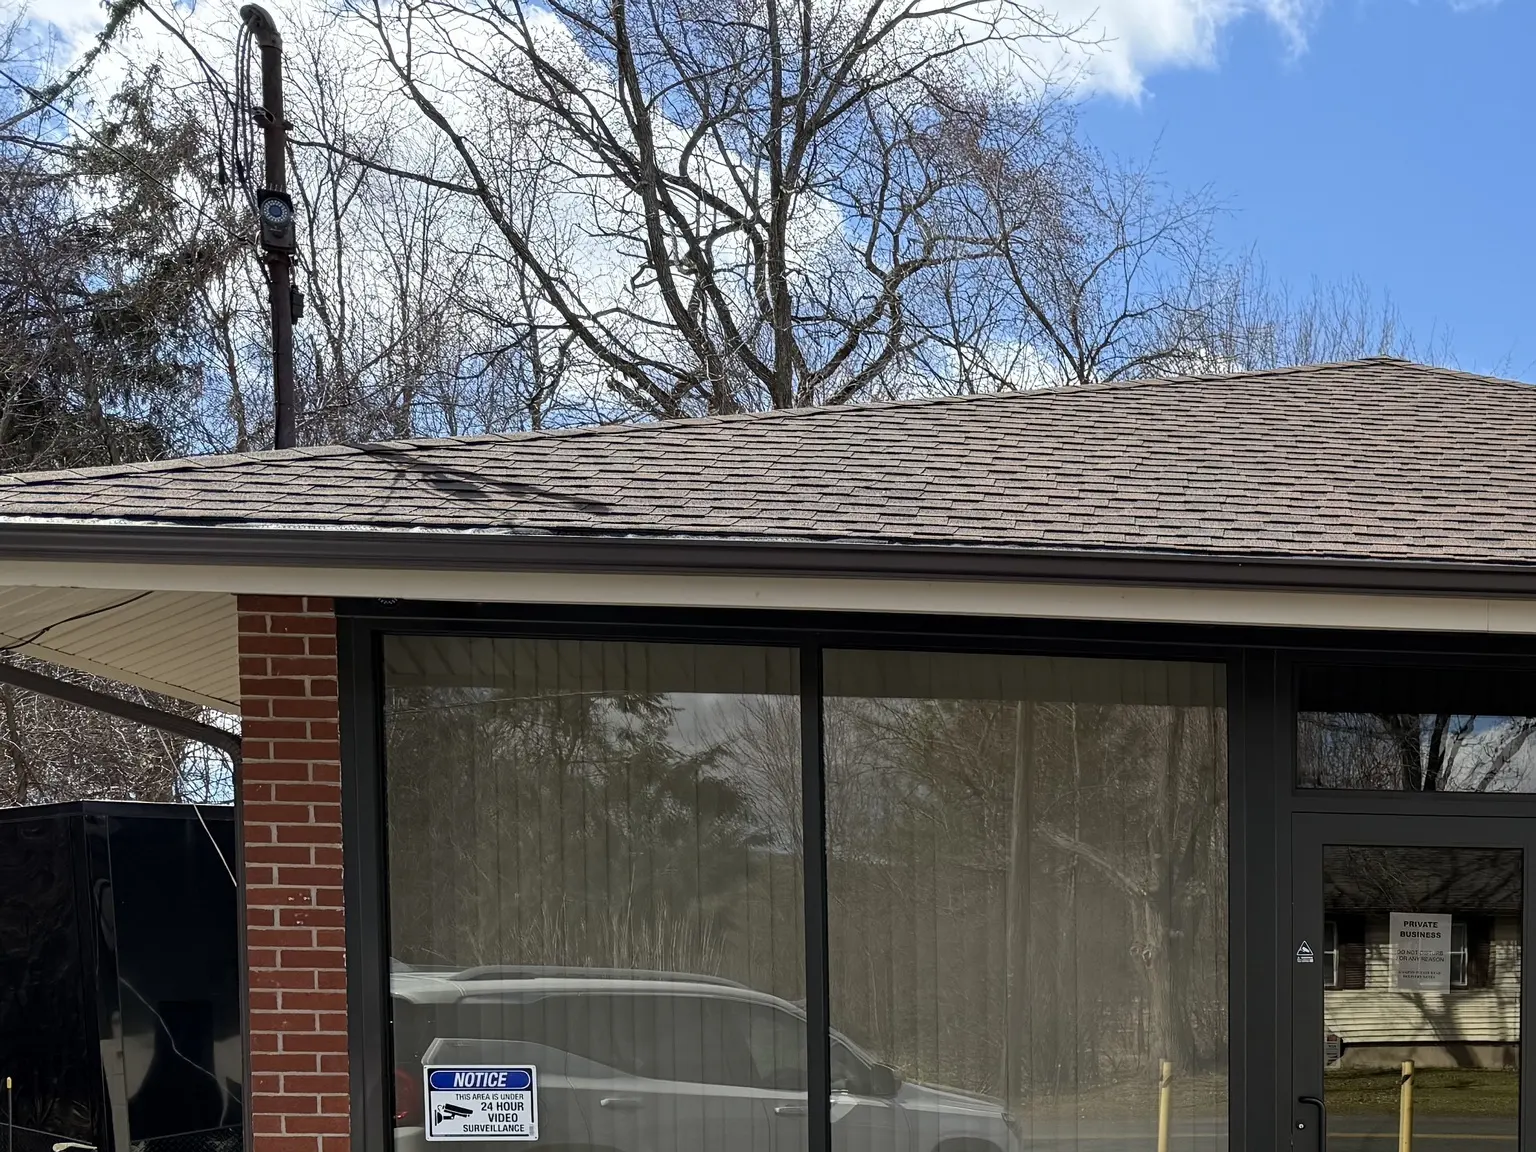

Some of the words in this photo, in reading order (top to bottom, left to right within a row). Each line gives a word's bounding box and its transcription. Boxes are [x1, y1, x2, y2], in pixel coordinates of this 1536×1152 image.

[1403, 920, 1439, 928] PRIVATE
[1400, 930, 1442, 939] BUSINESS
[453, 1072, 508, 1087] NOTICE
[480, 1102, 493, 1111] 24
[496, 1102, 524, 1111] HOUR
[488, 1113, 518, 1123] VIDEO
[463, 1124, 525, 1132] SURVEILLANCE
